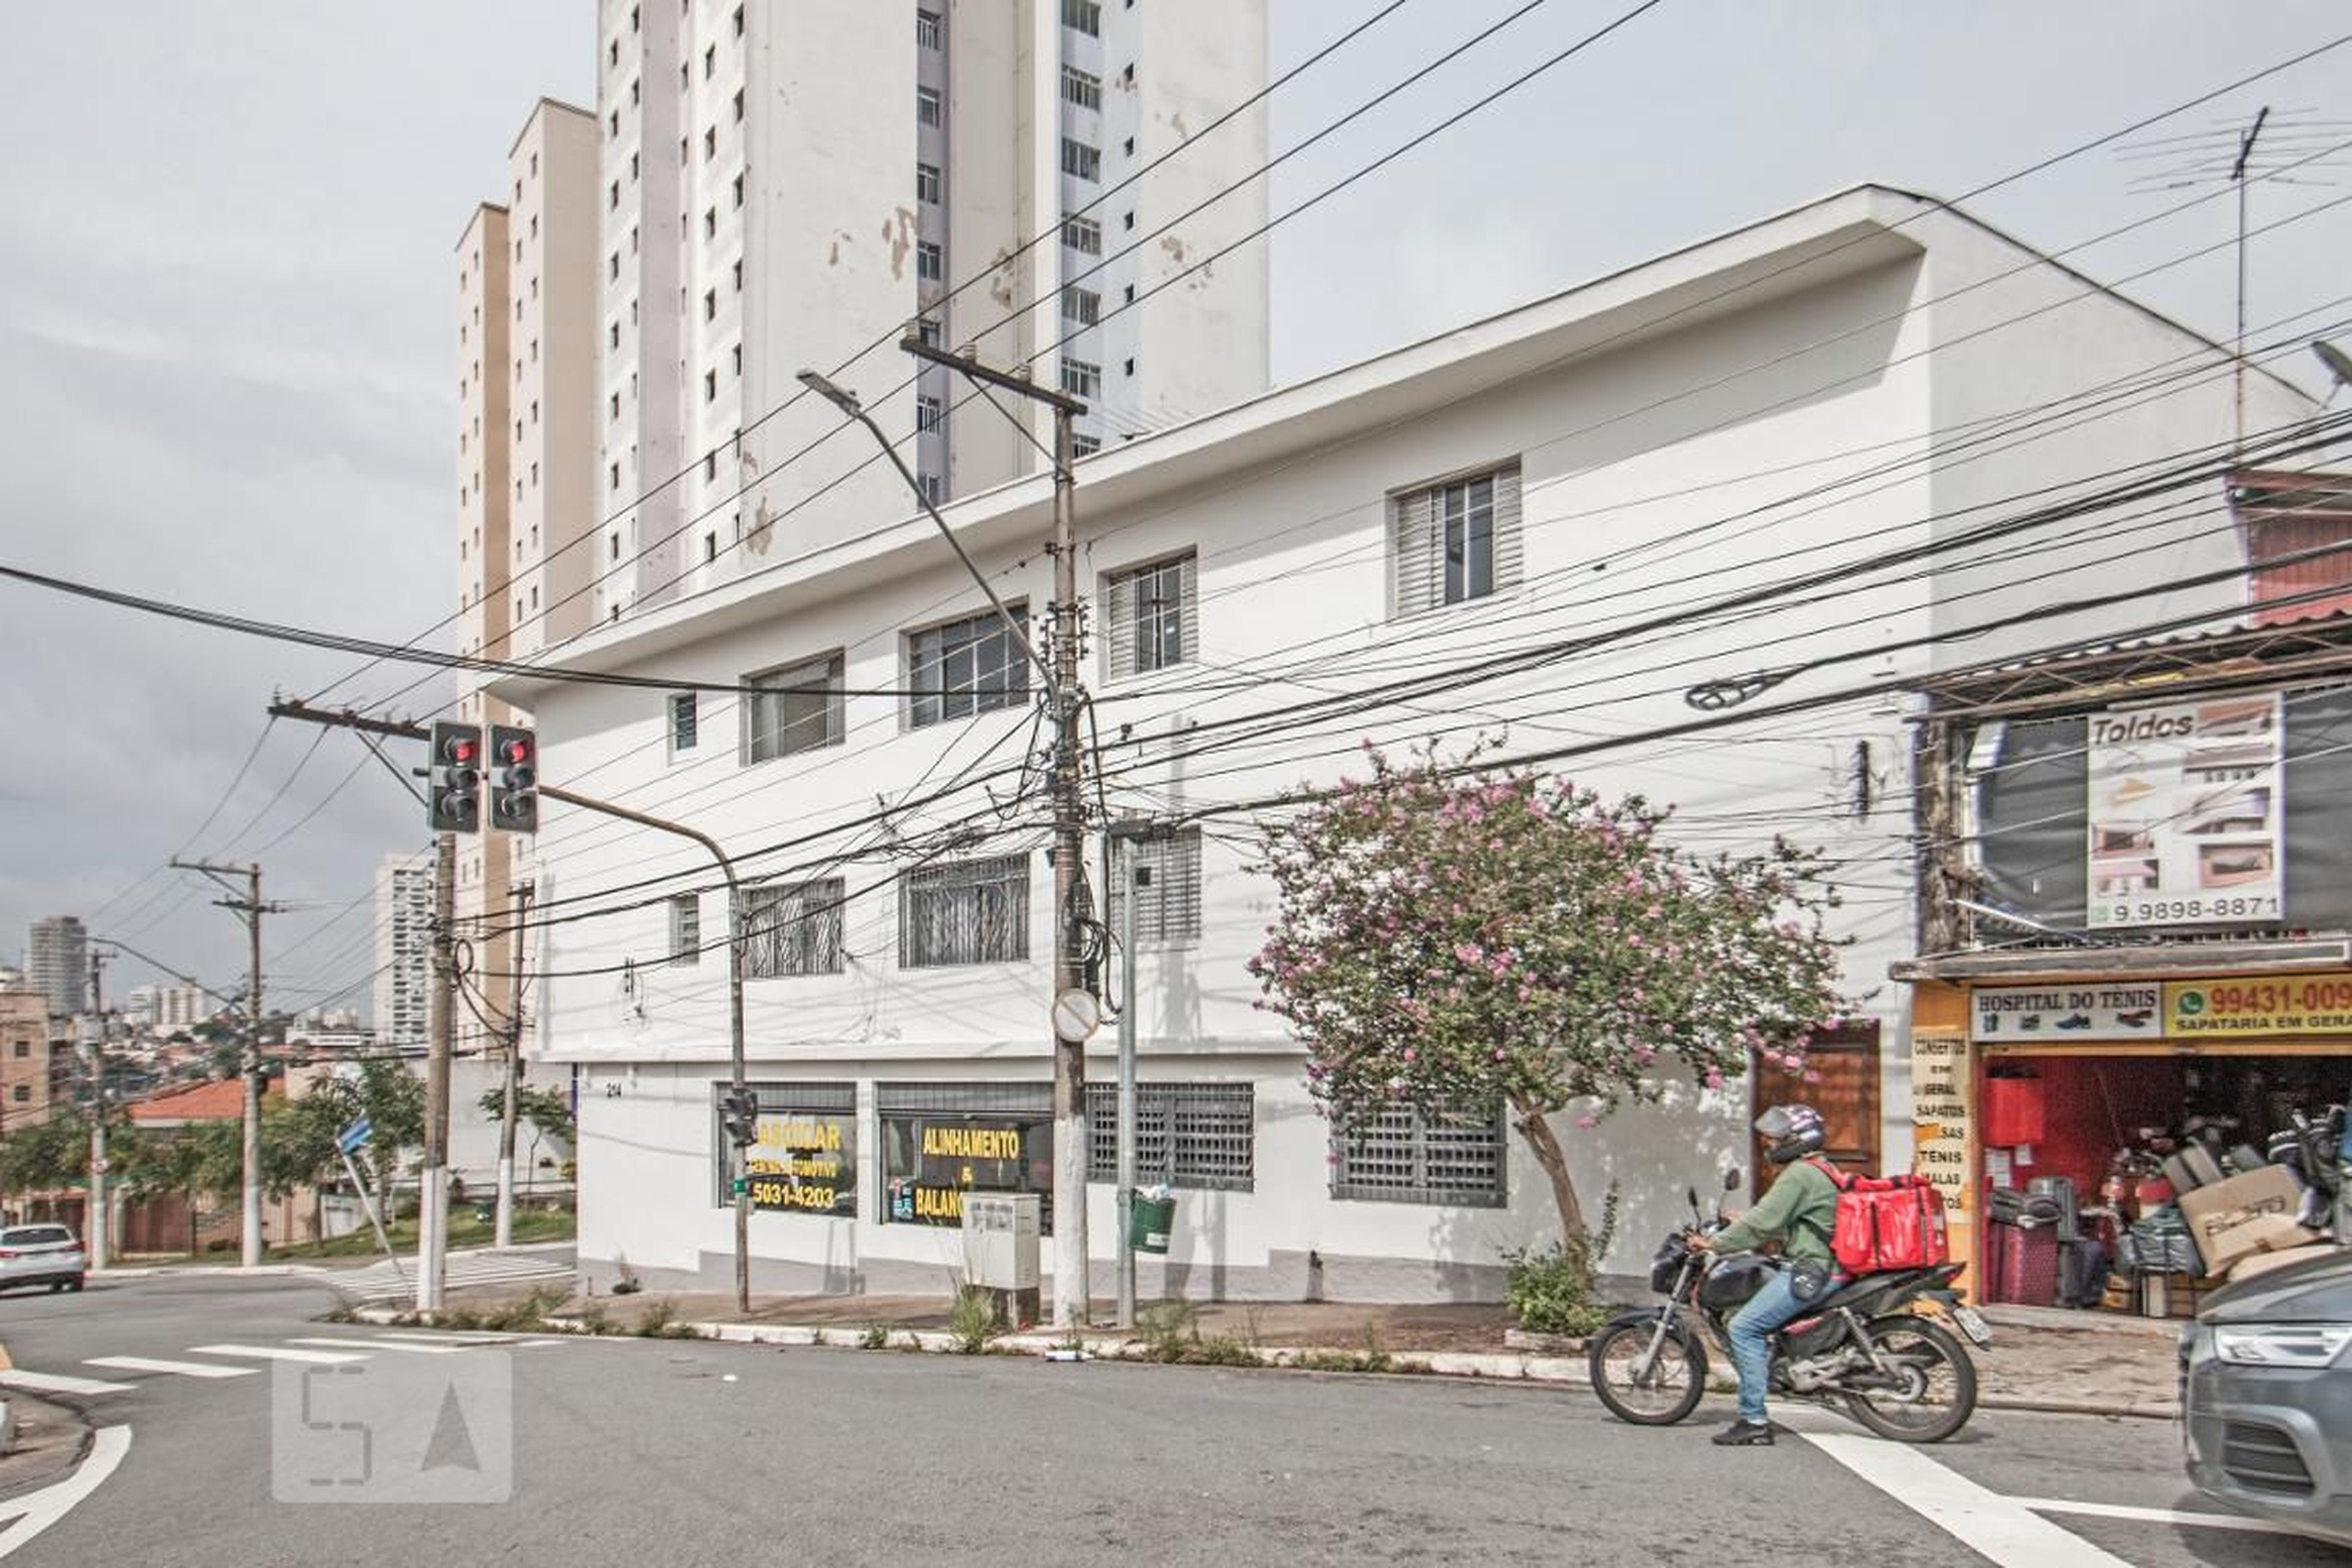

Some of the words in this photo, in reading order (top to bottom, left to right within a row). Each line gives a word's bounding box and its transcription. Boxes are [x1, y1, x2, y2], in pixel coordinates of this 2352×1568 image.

[2094, 714, 2194, 744] Toldos
[2114, 898, 2278, 921] 9.9898-8871
[1979, 993, 2062, 1012] HOSPITAL
[2068, 992, 2094, 1009] DO
[2211, 982, 2352, 1014] 99431-009
[2176, 1017, 2270, 1031] SAPATARIA
[2277, 1016, 2302, 1028] EM
[2308, 1015, 2352, 1028] GERA
[1924, 1084, 1956, 1095] GERAL
[1915, 1104, 1966, 1118] SAPATOS
[923, 1127, 1020, 1159] ALINHAMENTO
[1918, 1150, 1963, 1164] TENIS
[753, 1183, 835, 1208] 5031-4203
